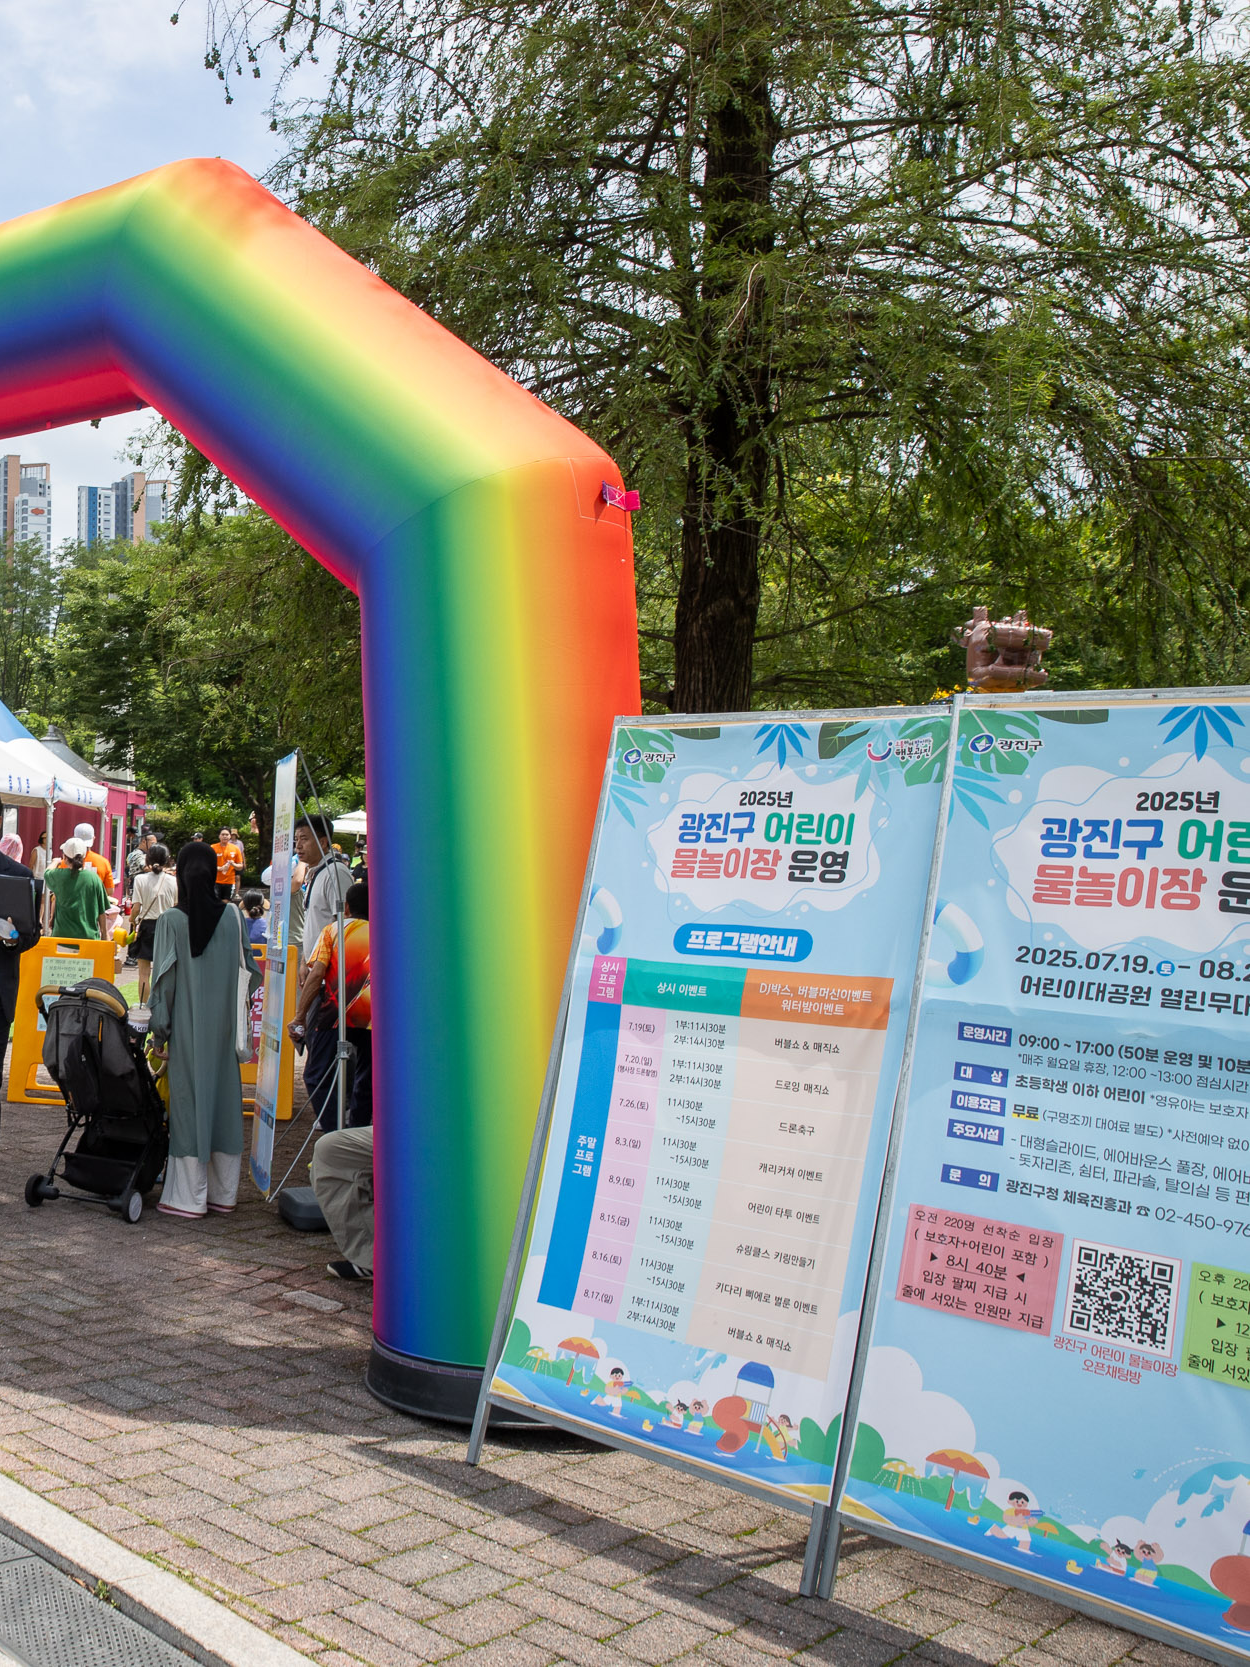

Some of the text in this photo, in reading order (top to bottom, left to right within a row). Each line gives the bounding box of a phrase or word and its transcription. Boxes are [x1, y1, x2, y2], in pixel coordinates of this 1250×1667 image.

[997, 739, 1044, 751] 광진구
[644, 752, 676, 763] 광진구
[739, 790, 793, 808] 2025년
[1135, 790, 1220, 814] 2025년
[679, 812, 855, 846] 광진구 어린이
[1040, 818, 1164, 860] 광진구
[670, 847, 849, 884] 물놀이장 운영
[1032, 864, 1207, 911] 물놀이장
[686, 930, 798, 957] 프로그램안내
[601, 961, 620, 974] 상시
[598, 973, 616, 985] 프로
[597, 987, 615, 999] 그램
[657, 982, 707, 997] 상시 이벤트
[759, 982, 872, 1002] DJ박스, 버블머신이벤트
[1020, 975, 1152, 1006] 어린이대공원
[781, 999, 845, 1016] 워터밤이벤트
[675, 1020, 726, 1034] 1부:11시30분
[673, 1035, 725, 1050] 2부:14시30분
[774, 1038, 840, 1054] 버블쇼 매직쇼
[963, 1026, 1007, 1043] 운영시간
[1019, 1034, 1059, 1050] 09:00
[1075, 1040, 1114, 1057] 17:00
[1118, 1044, 1159, 1063] (50분
[1163, 1051, 1193, 1066] 운영
[1198, 1054, 1212, 1069] 및
[672, 1059, 723, 1075] 1부:11시30분
[1047, 1056, 1080, 1072] 월요일
[1113, 1065, 1146, 1079] 12:00
[1196, 1075, 1249, 1094] 점심시간
[669, 1074, 721, 1089] 2부:14시30분
[775, 1079, 830, 1096] 드로잉 매직쇼
[960, 1066, 972, 1079] 대
[991, 1070, 1003, 1083] 상
[1015, 1075, 1068, 1094] 초등학생
[1072, 1082, 1099, 1098] 이하
[1104, 1087, 1145, 1104] 어린이
[1209, 1102, 1249, 1119] 보호자
[667, 1098, 703, 1112] 11시30분
[956, 1094, 1001, 1112] 이용요금
[1013, 1104, 1039, 1120] 무료
[1095, 1117, 1130, 1133] 대여료
[1134, 1123, 1163, 1138] 별도)
[778, 1121, 815, 1136] 드론축구
[577, 1135, 597, 1149] 주말
[662, 1137, 697, 1151] 11시30분
[953, 1123, 999, 1141] 주요시설
[1103, 1147, 1172, 1172] 에어바운스
[574, 1149, 594, 1162] 프로
[572, 1163, 592, 1177] 그램
[797, 1168, 823, 1182] 이벤트
[655, 1176, 690, 1192] 11시30분
[949, 1168, 961, 1182] 문
[978, 1174, 991, 1187] 의
[1006, 1179, 1059, 1201] 광진구청
[1063, 1190, 1132, 1215] 체육진흥과
[1165, 1178, 1210, 1199] 탈의실
[1215, 1186, 1230, 1202] 등
[748, 1202, 820, 1225] 어린이 타투 이벤트
[649, 1216, 683, 1231] 11시30분
[914, 1210, 1054, 1249] 오전 220명 선착순 입장
[640, 1257, 674, 1274] 11시30분
[773, 1251, 816, 1270] 키링만들기
[1011, 1249, 1037, 1266] 포함
[946, 1255, 1008, 1280] 8시 40분
[1198, 1270, 1226, 1285] 오후
[922, 1270, 1027, 1305] 입장 팔찌 지급 시
[631, 1296, 680, 1317] 1부:11시30분
[715, 1281, 743, 1298] 키다리
[793, 1300, 818, 1315] 이벤트
[902, 1285, 1044, 1330] 줄에 서있는 인원만 지급
[626, 1311, 676, 1332] 2부:14시30분
[727, 1326, 792, 1352] 버블쇼 매직쇼
[1211, 1338, 1238, 1357] 입장
[1054, 1335, 1178, 1377] 광진구 어린이 물놀이장
[1188, 1353, 1215, 1373] 줄에
[1082, 1359, 1142, 1385] 오픈채팅방
